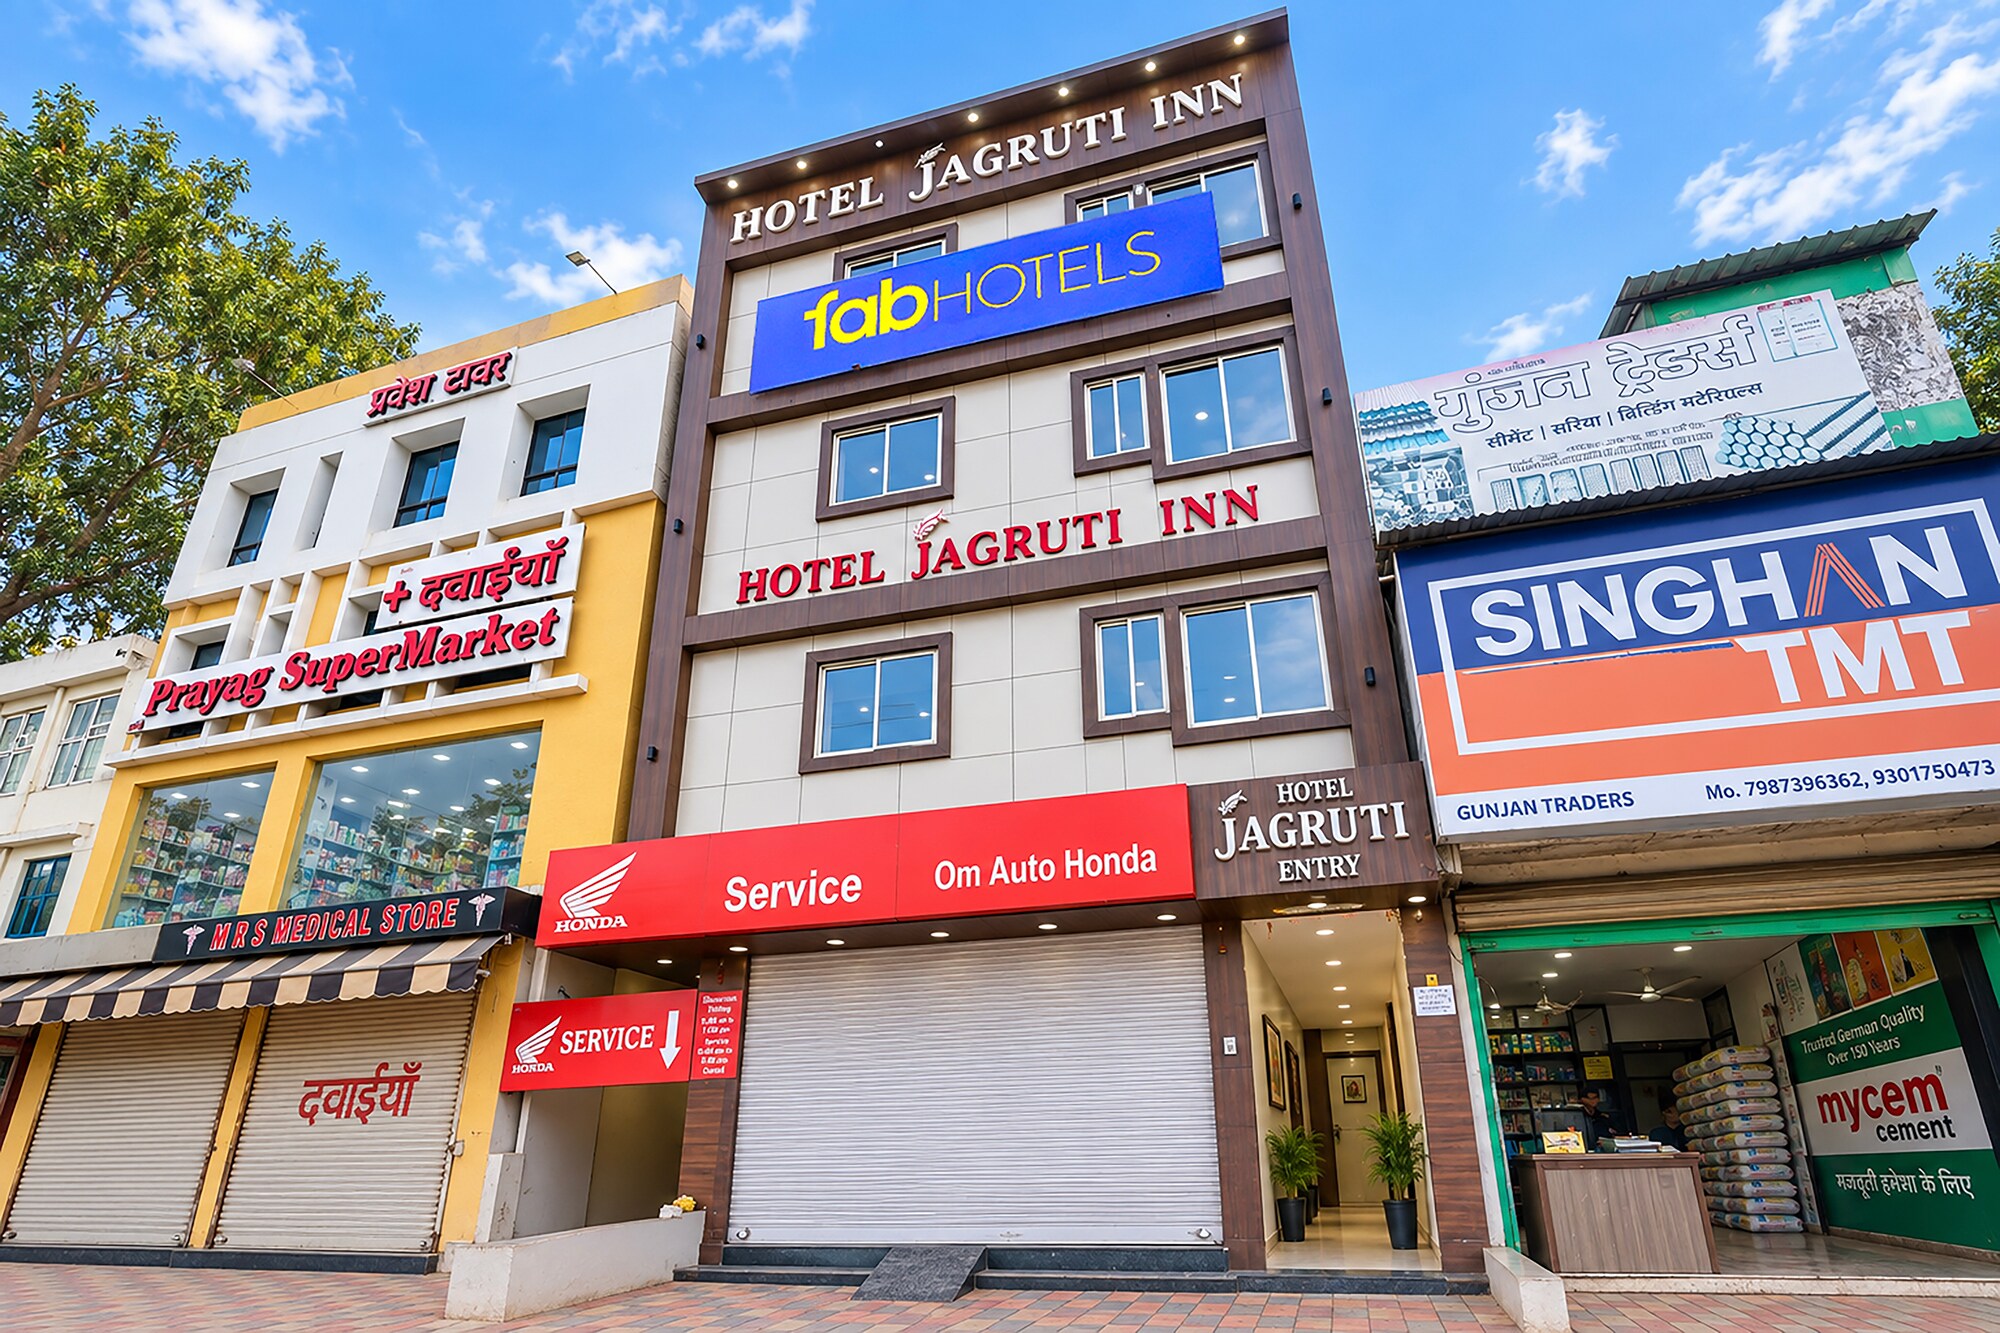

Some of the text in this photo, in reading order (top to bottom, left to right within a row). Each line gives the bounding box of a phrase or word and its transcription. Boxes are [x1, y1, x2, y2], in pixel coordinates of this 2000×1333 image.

[728, 72, 1242, 244] HOTEL JAGRUTI INN
[367, 351, 513, 417] प्रवेश टावर
[1434, 314, 1757, 433] गुंजन ट्रेडर्स
[1485, 427, 1534, 449] सीमेंट
[1550, 414, 1602, 435] सरिया
[736, 484, 1260, 604] HOTEL JAGRUTI INN
[1469, 526, 1968, 657] SINGHAN
[143, 607, 560, 717] Prayag SuperMarket
[1733, 610, 1971, 704] TMT
[1276, 776, 1353, 804] HOTEL
[1705, 759, 1995, 800] Mo. 7987396362, 9301750473
[1456, 791, 1635, 821] GUNJAN TRADERS
[1215, 801, 1410, 862] JAGRUTI
[934, 843, 1158, 891] Om Auto Honda
[1278, 853, 1361, 883] ENTRY
[724, 869, 862, 913] Service
[270, 907, 372, 945] MEDICAL
[379, 898, 460, 934] STORE
[553, 915, 628, 933] HONDA
[560, 1025, 655, 1054] SERVICE
[1837, 1020, 1879, 1043] German
[1880, 1004, 1925, 1032] Quality
[511, 1062, 555, 1074] HONDA
[1826, 1036, 1901, 1066] Over 150 Years
[1816, 1073, 1949, 1133] mycem
[1875, 1115, 1956, 1142] cement
[1918, 1167, 1937, 1193] के
[1937, 1168, 1975, 1199] लिए
